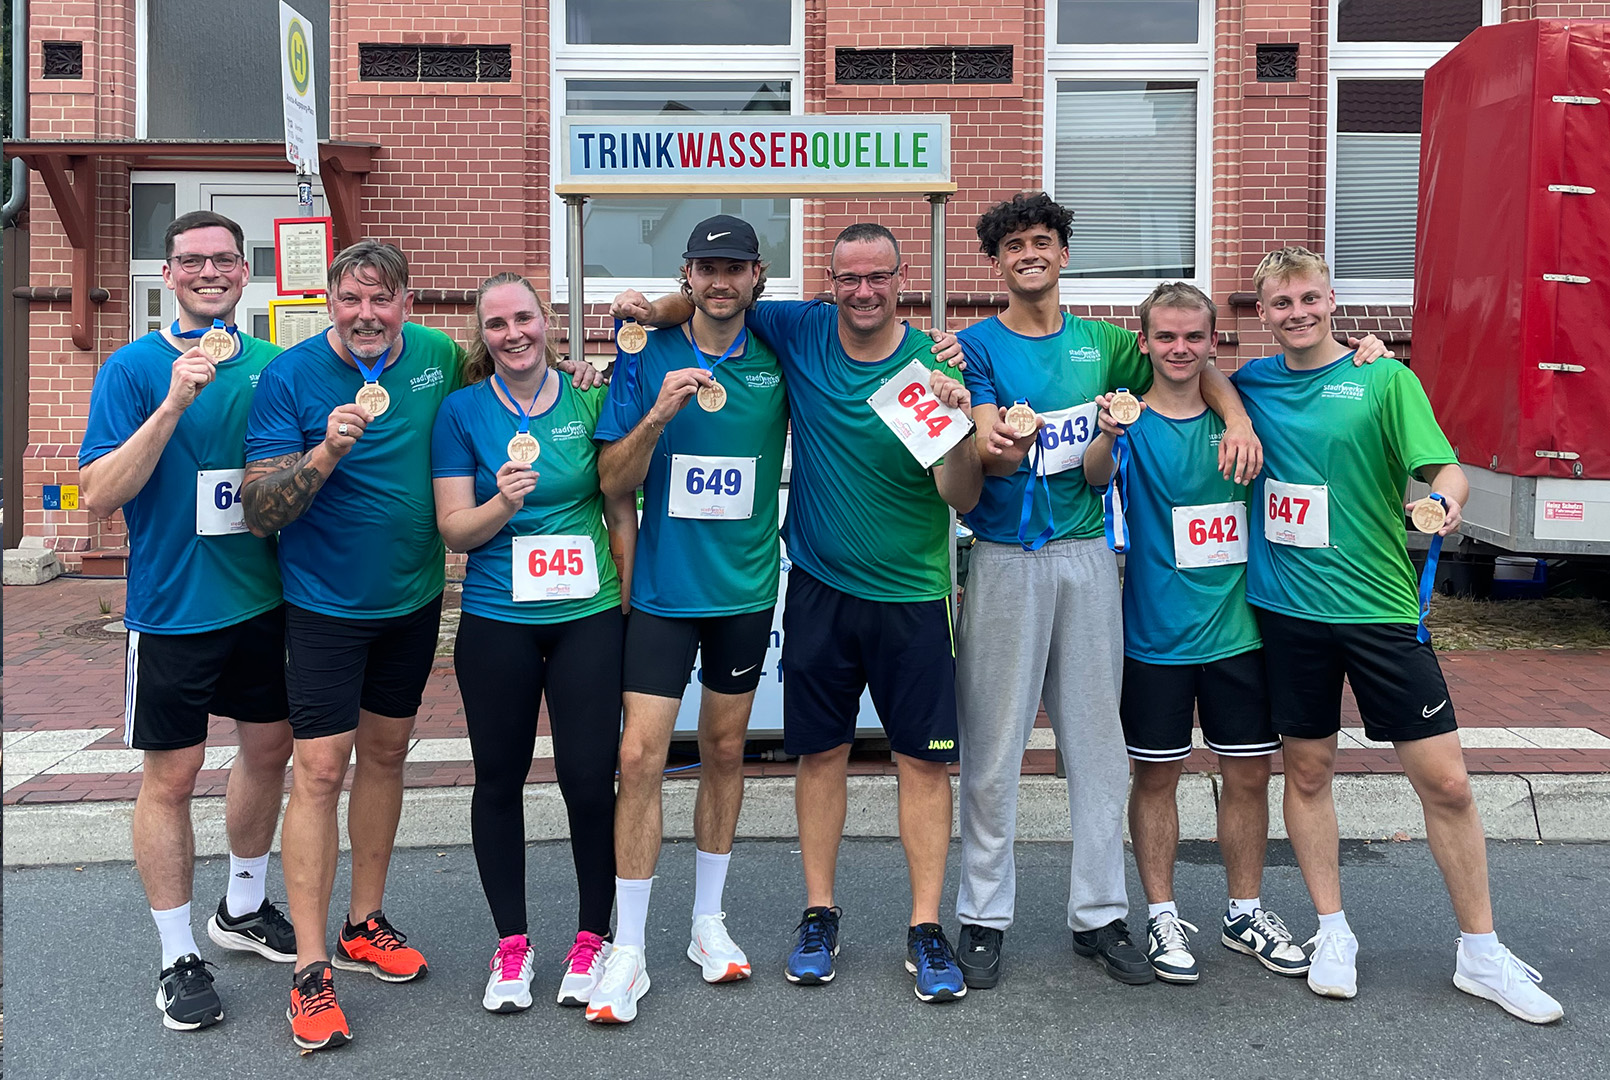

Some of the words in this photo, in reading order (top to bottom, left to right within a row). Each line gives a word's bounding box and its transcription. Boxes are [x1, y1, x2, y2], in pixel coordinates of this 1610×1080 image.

[294, 38, 303, 76] H
[577, 131, 929, 170] TRINKWASSERQUELLE
[1323, 384, 1365, 392] stadtwerke
[897, 382, 953, 439] 644
[1040, 415, 1089, 451] 643
[685, 467, 742, 496] 649
[1268, 492, 1311, 525] 647
[1188, 515, 1239, 546] 642
[528, 548, 584, 577] 645
[928, 740, 955, 750] JAKO
